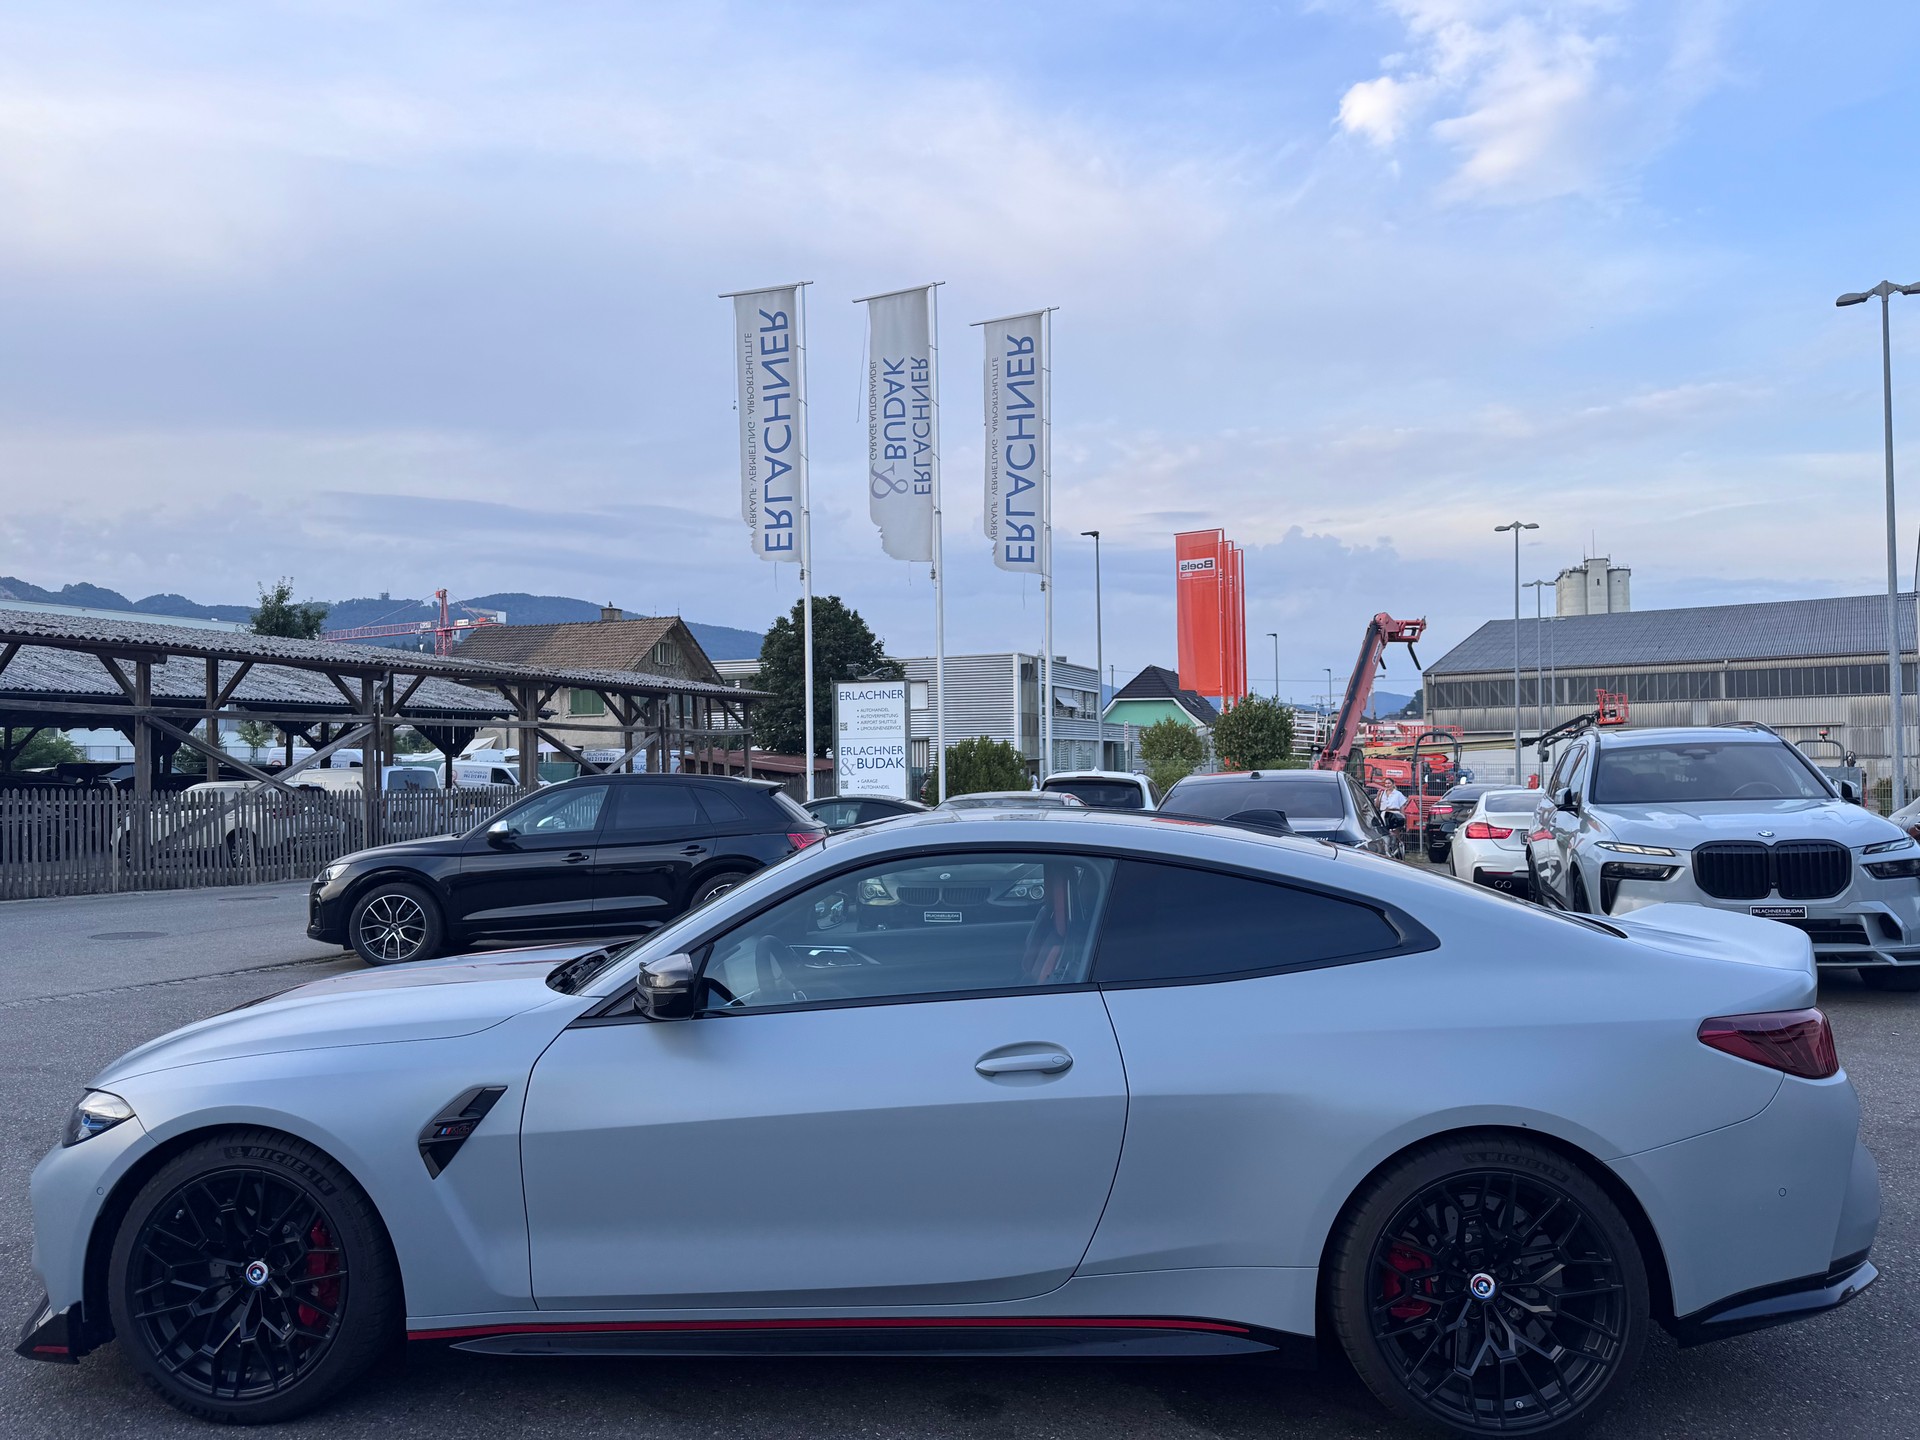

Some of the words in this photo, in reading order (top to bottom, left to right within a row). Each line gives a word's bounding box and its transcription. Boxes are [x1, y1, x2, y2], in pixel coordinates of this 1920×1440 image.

[839, 689, 904, 701] ERLACHNER
[840, 745, 904, 756] ERLACHNER
[839, 757, 856, 776] &
[856, 757, 905, 769] BUDAK
[248, 1147, 335, 1195] MICHELIN
[1485, 1152, 1568, 1182] MICHELIN
